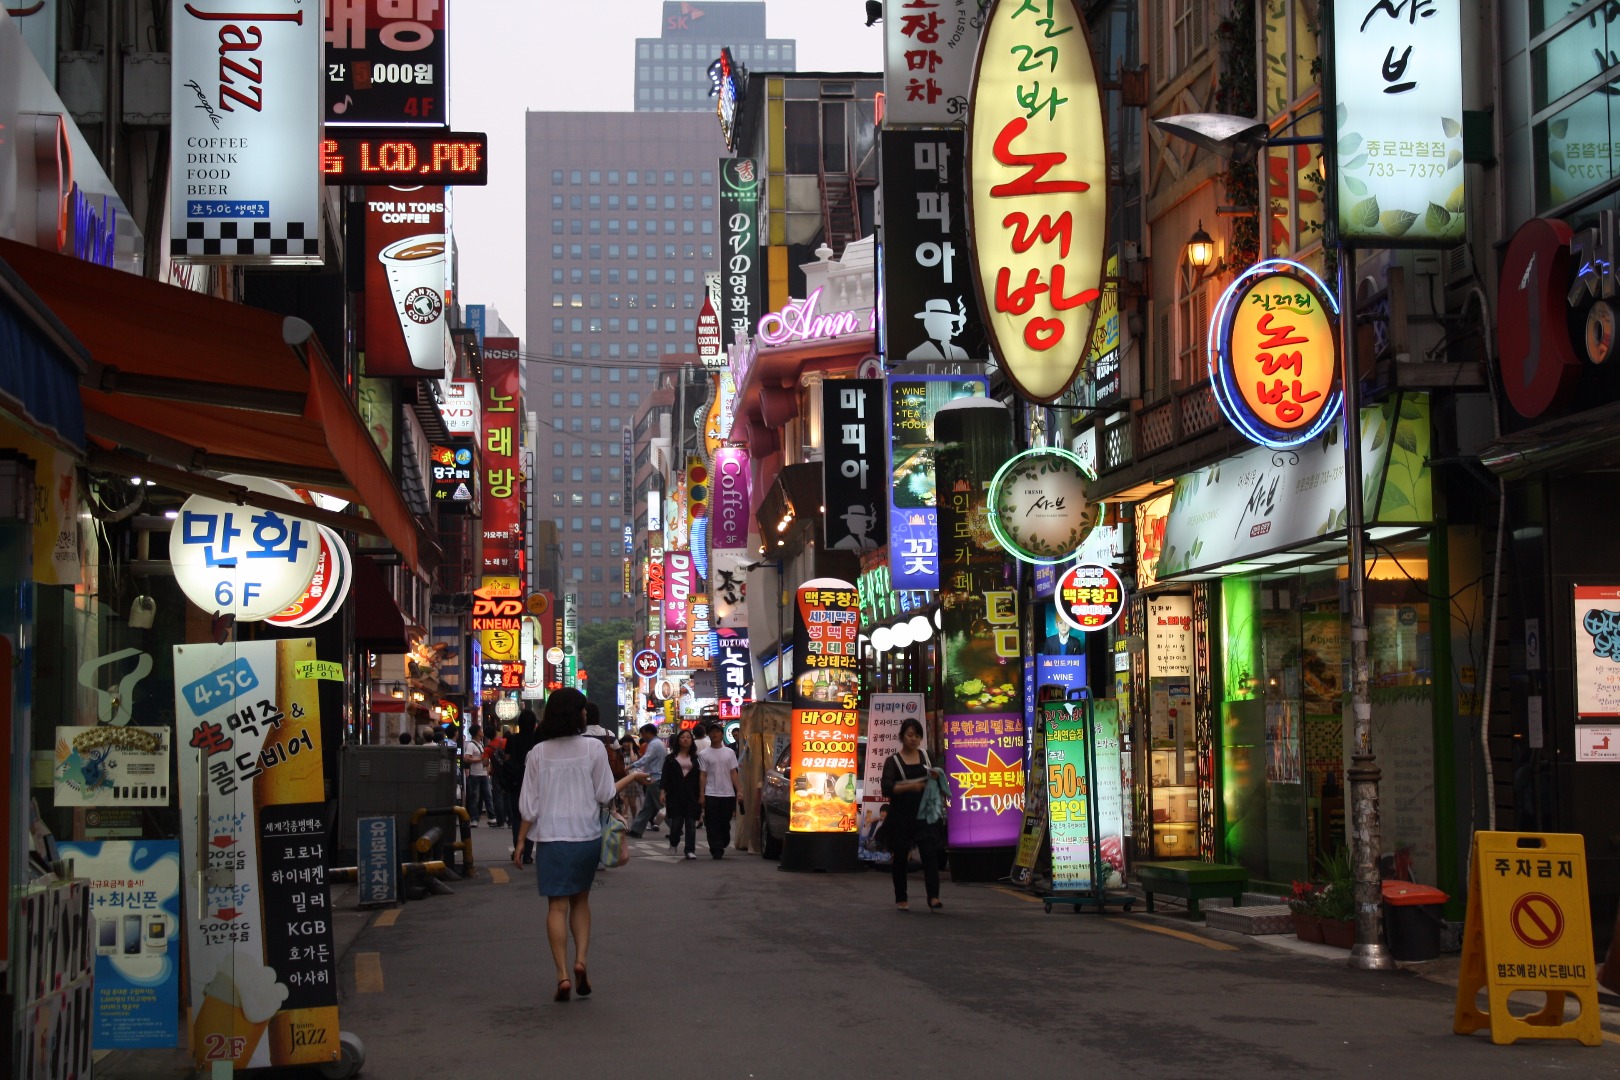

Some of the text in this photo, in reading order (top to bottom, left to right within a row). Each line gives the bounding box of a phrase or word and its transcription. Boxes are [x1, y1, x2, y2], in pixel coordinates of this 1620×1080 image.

[667, 16, 689, 30] SK
[183, 3, 303, 114] Jazz
[900, 0, 946, 104] 장마차
[183, 79, 223, 130] people
[403, 97, 434, 117] 4F
[187, 137, 249, 149] COFFEE
[1366, 140, 1447, 158] 종로관철점
[187, 153, 238, 164] DRINK
[187, 168, 231, 180] FOOD
[1367, 162, 1447, 178] 733-7379
[187, 184, 228, 195] BEER
[368, 202, 444, 213] TOM N TOMS
[914, 142, 956, 284] 마피아
[382, 213, 430, 224] COFFEE
[990, 117, 1100, 351] 노래방
[406, 288, 419, 306] TOM
[426, 289, 442, 307] TOMS
[408, 310, 439, 323] COFFEE
[700, 315, 716, 324] WINE
[758, 284, 859, 345] Ann
[698, 326, 719, 335] WHISKY
[698, 336, 720, 345] COCKTAIL
[700, 346, 717, 355] BEER
[1255, 313, 1322, 423] 노래방
[901, 387, 926, 396] WINE
[901, 399, 921, 408] HOF
[901, 422, 928, 430] FOOD
[487, 386, 516, 498] 노래방
[840, 388, 869, 489] 마피아
[435, 489, 448, 499] 4F
[721, 457, 743, 533] Coffee
[182, 510, 309, 569] 만화
[725, 536, 738, 544] 3F
[901, 538, 937, 575] 꽃
[671, 553, 690, 600] DVD
[214, 580, 262, 607] 6F
[804, 590, 860, 607] 맥주창고
[1063, 588, 1119, 603] 맥주창고
[473, 600, 523, 617] DVD
[809, 610, 857, 624] 세계맥주
[473, 618, 520, 630] KINEMA
[1083, 616, 1099, 625] 5F
[1157, 616, 1192, 632] 노래방
[691, 603, 711, 661] 종로포차
[808, 625, 857, 640] 생맥주
[721, 647, 748, 706] 노래방
[1053, 673, 1074, 681] WINE
[291, 702, 304, 719] &
[842, 694, 858, 710] 5F
[874, 702, 905, 713] 마피아
[801, 711, 858, 727] 바이킹
[802, 741, 855, 754] 10,000
[208, 728, 313, 797] 콜드비어
[1049, 762, 1087, 799] 50%
[1050, 798, 1087, 822] 할인
[838, 815, 856, 832] 4F
[282, 844, 324, 860] 코로나
[370, 821, 390, 901] 유료주차장
[1495, 858, 1573, 879] 주차금지
[271, 865, 325, 885] 하이네켄
[291, 892, 325, 913] 밀러
[199, 922, 251, 935] 500cc
[287, 920, 327, 936] KGB
[288, 943, 330, 963] 호가든
[289, 969, 330, 987] 아사히
[205, 1033, 247, 1061] 2F
[289, 1023, 328, 1055] Jazz
